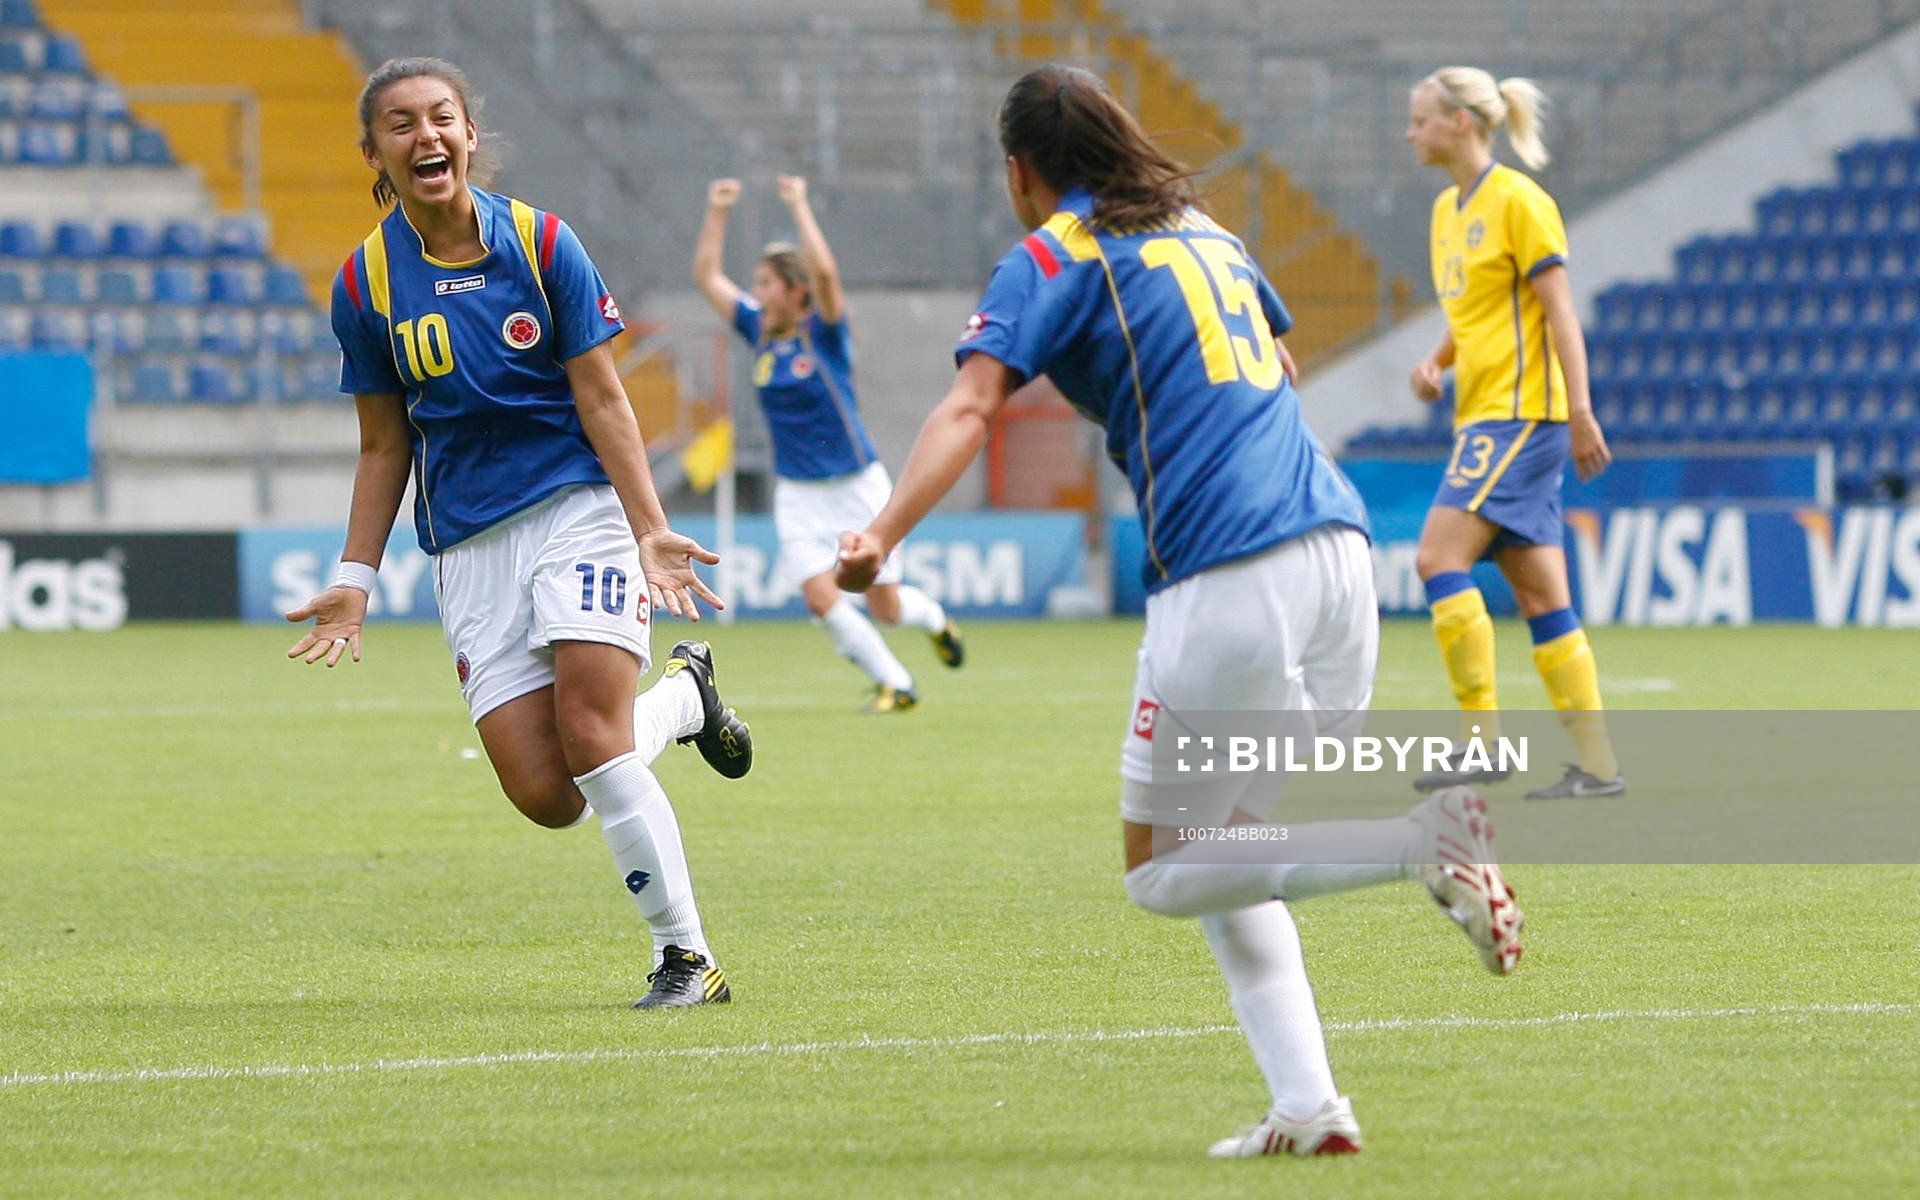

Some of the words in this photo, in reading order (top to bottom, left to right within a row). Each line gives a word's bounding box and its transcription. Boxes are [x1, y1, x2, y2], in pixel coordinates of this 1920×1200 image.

[450, 280, 482, 289] lotto
[1138, 237, 1284, 390] 15
[395, 313, 454, 382] 10
[1446, 432, 1495, 479] 13
[0, 540, 128, 630] as
[272, 552, 428, 615] SY
[576, 562, 627, 616] 10
[1566, 507, 1751, 627] VISA
